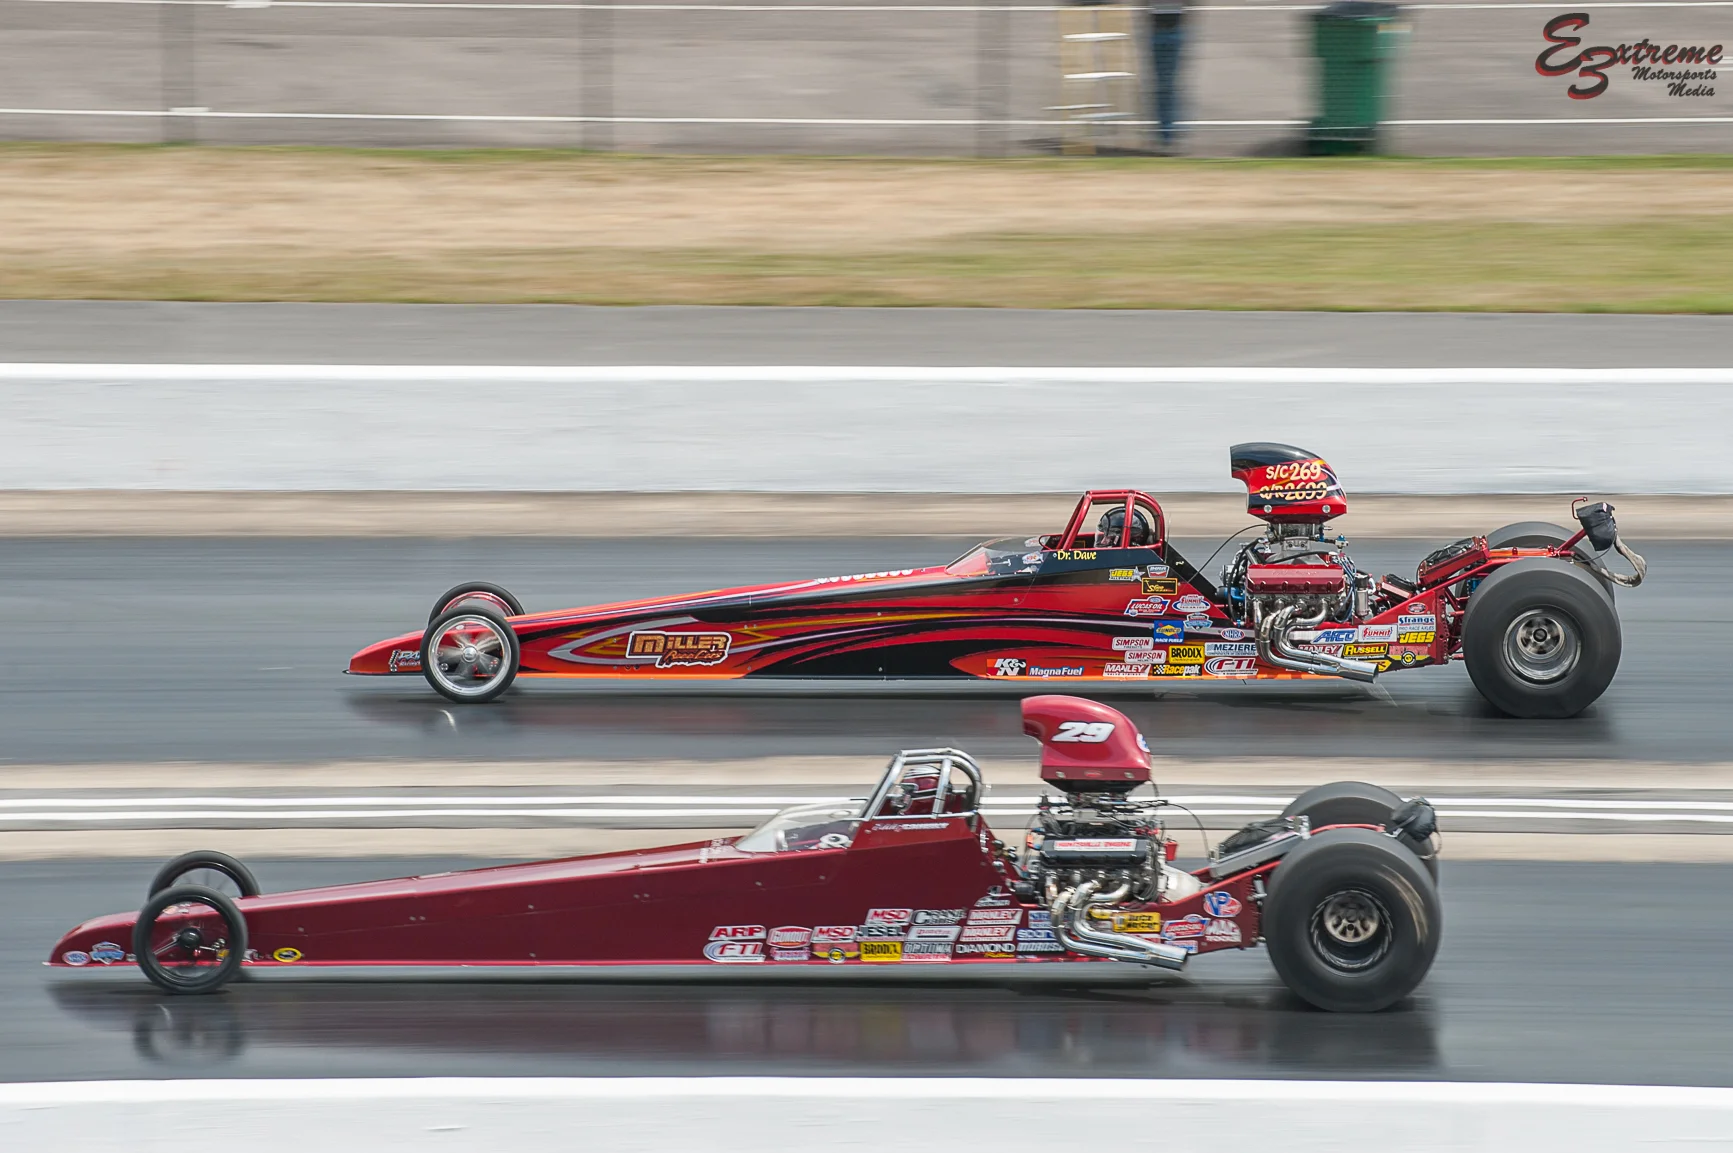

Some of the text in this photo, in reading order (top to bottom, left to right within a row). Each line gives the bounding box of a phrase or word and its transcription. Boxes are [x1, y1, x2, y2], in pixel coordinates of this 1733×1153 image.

[1057, 550, 1097, 560] Dr. Dave
[1111, 569, 1134, 578] JEGS
[1399, 632, 1435, 644] JEGS
[633, 635, 728, 653] MILLER
[1128, 652, 1162, 660] SIMPSON
[1171, 647, 1203, 658] BRODIX
[1345, 645, 1385, 656] RUSSELL
[1029, 667, 1083, 678] MagnaFuel
[1105, 664, 1145, 672] MANLEY
[1164, 664, 1201, 677] Racepak
[1051, 721, 1116, 743] 29
[715, 927, 762, 938] ARP
[956, 943, 1016, 954] DIAMOND
